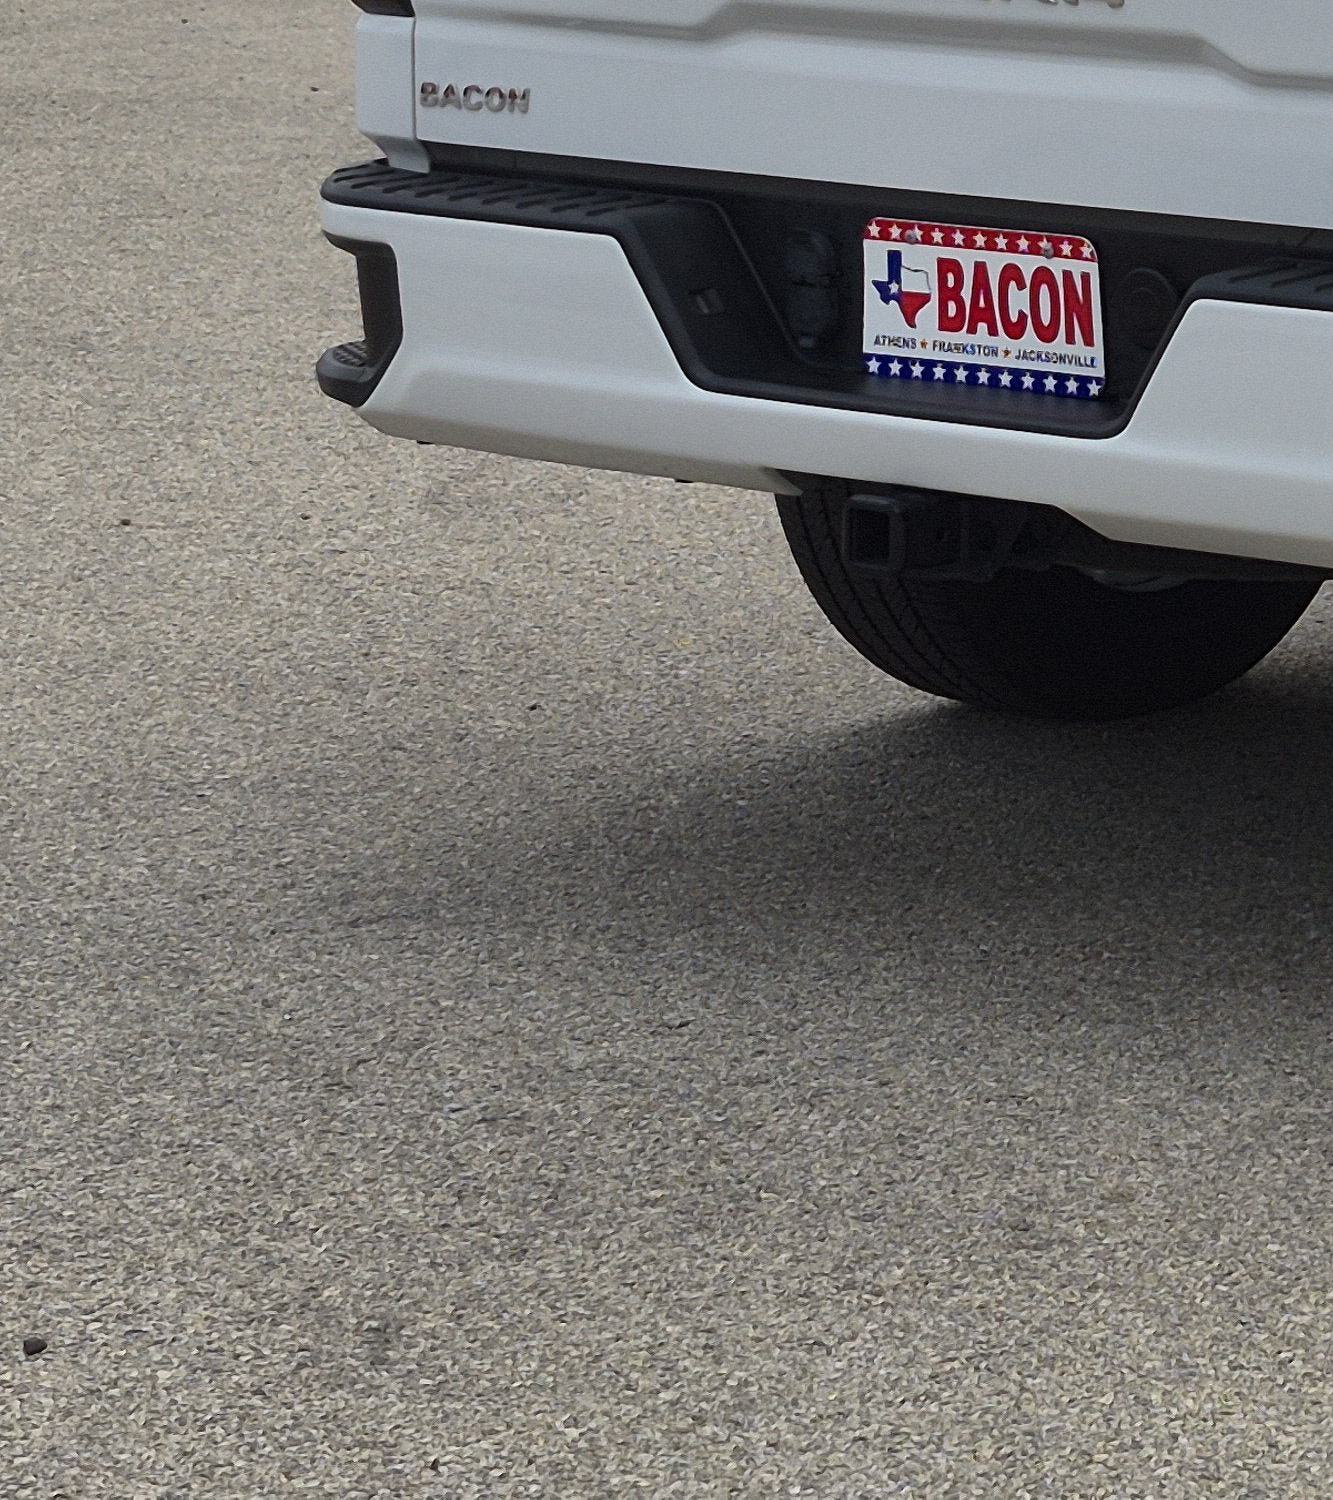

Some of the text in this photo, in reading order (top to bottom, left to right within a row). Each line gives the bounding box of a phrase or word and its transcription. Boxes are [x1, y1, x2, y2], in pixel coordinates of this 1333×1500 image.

[419, 81, 531, 115] BACON
[936, 257, 1095, 347] BACON
[873, 334, 1097, 368] ATHENS FRANKSTON JACKSONVILLE
